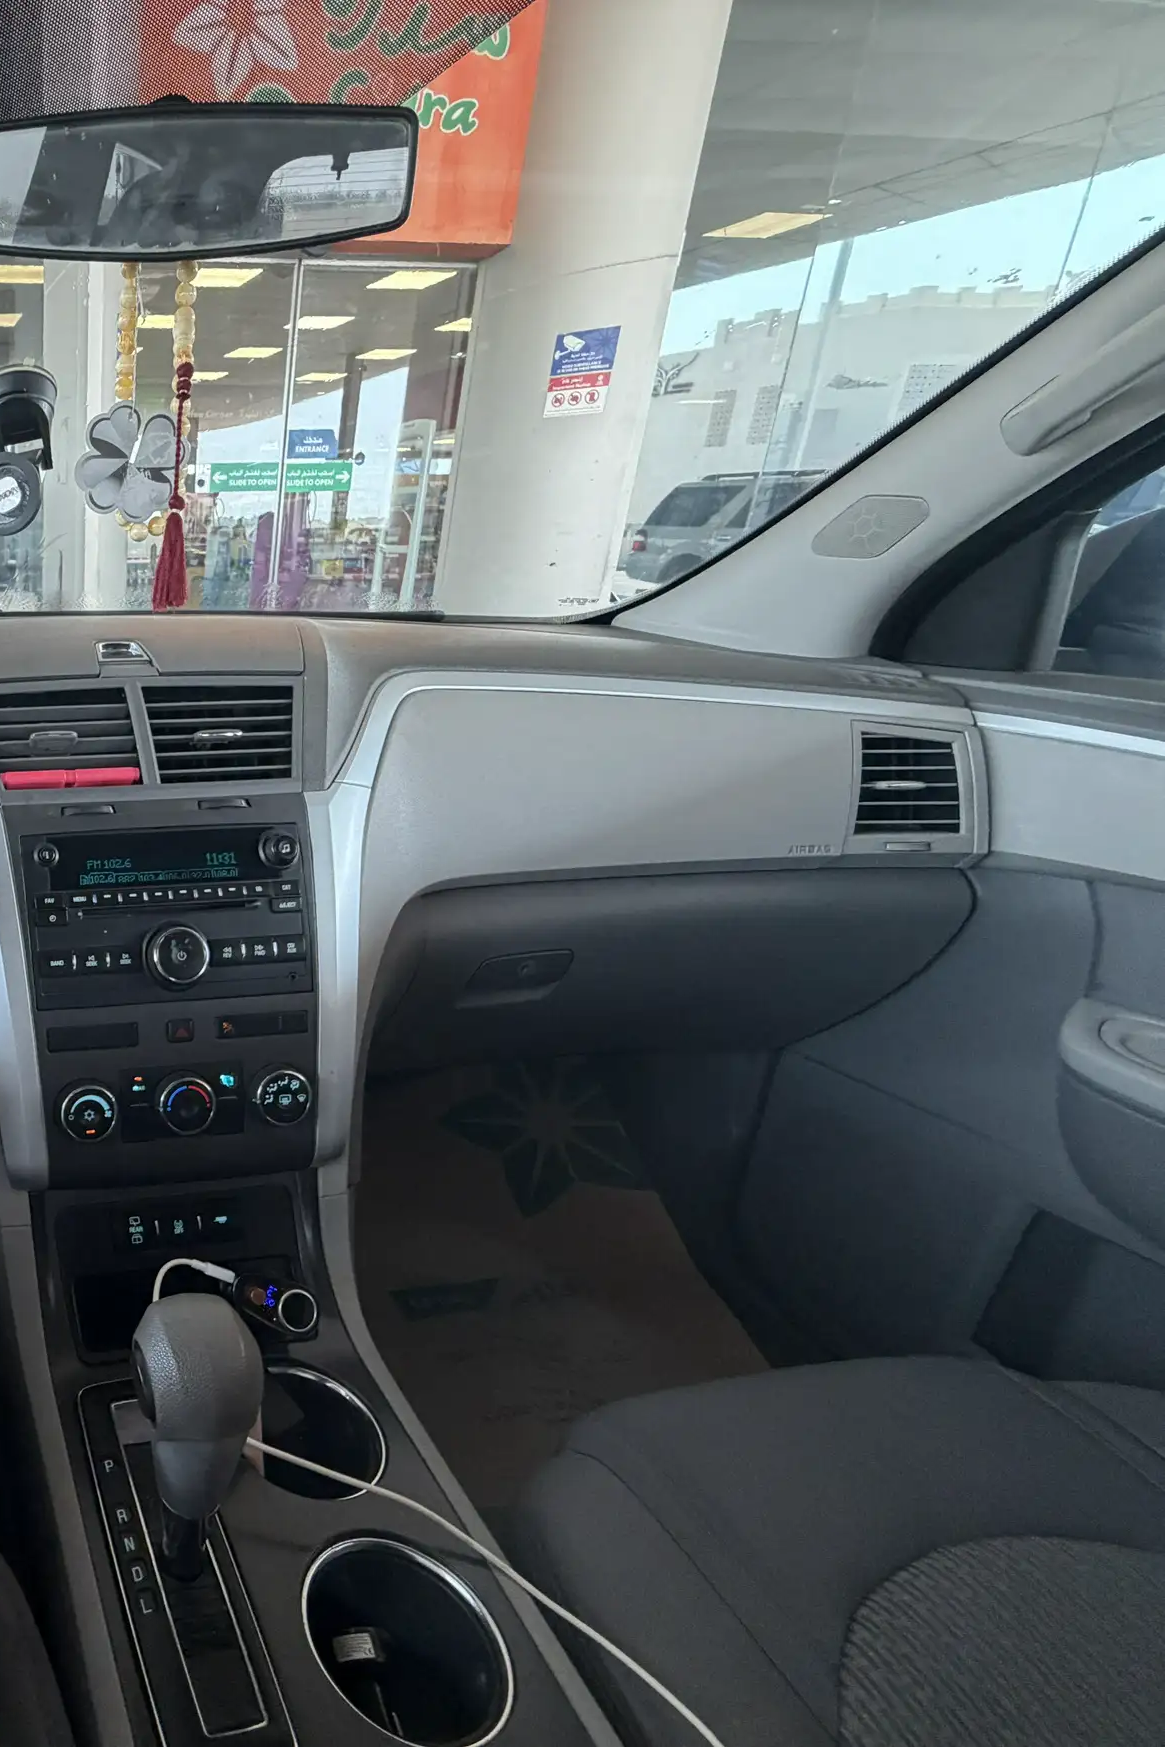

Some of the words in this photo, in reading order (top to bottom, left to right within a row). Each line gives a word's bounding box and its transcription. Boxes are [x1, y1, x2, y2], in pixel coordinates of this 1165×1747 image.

[295, 444, 330, 453] ENTRANCE
[787, 844, 831, 855] AIRBAG
[86, 860, 103, 870] FM
[104, 858, 132, 869] 102.6
[206, 852, 237, 866] 11:31
[90, 874, 114, 884] 102.6
[104, 1459, 114, 1473] P
[116, 1508, 128, 1524] R
[124, 1536, 136, 1552] N
[131, 1566, 144, 1582] D
[140, 1598, 153, 1614] L
